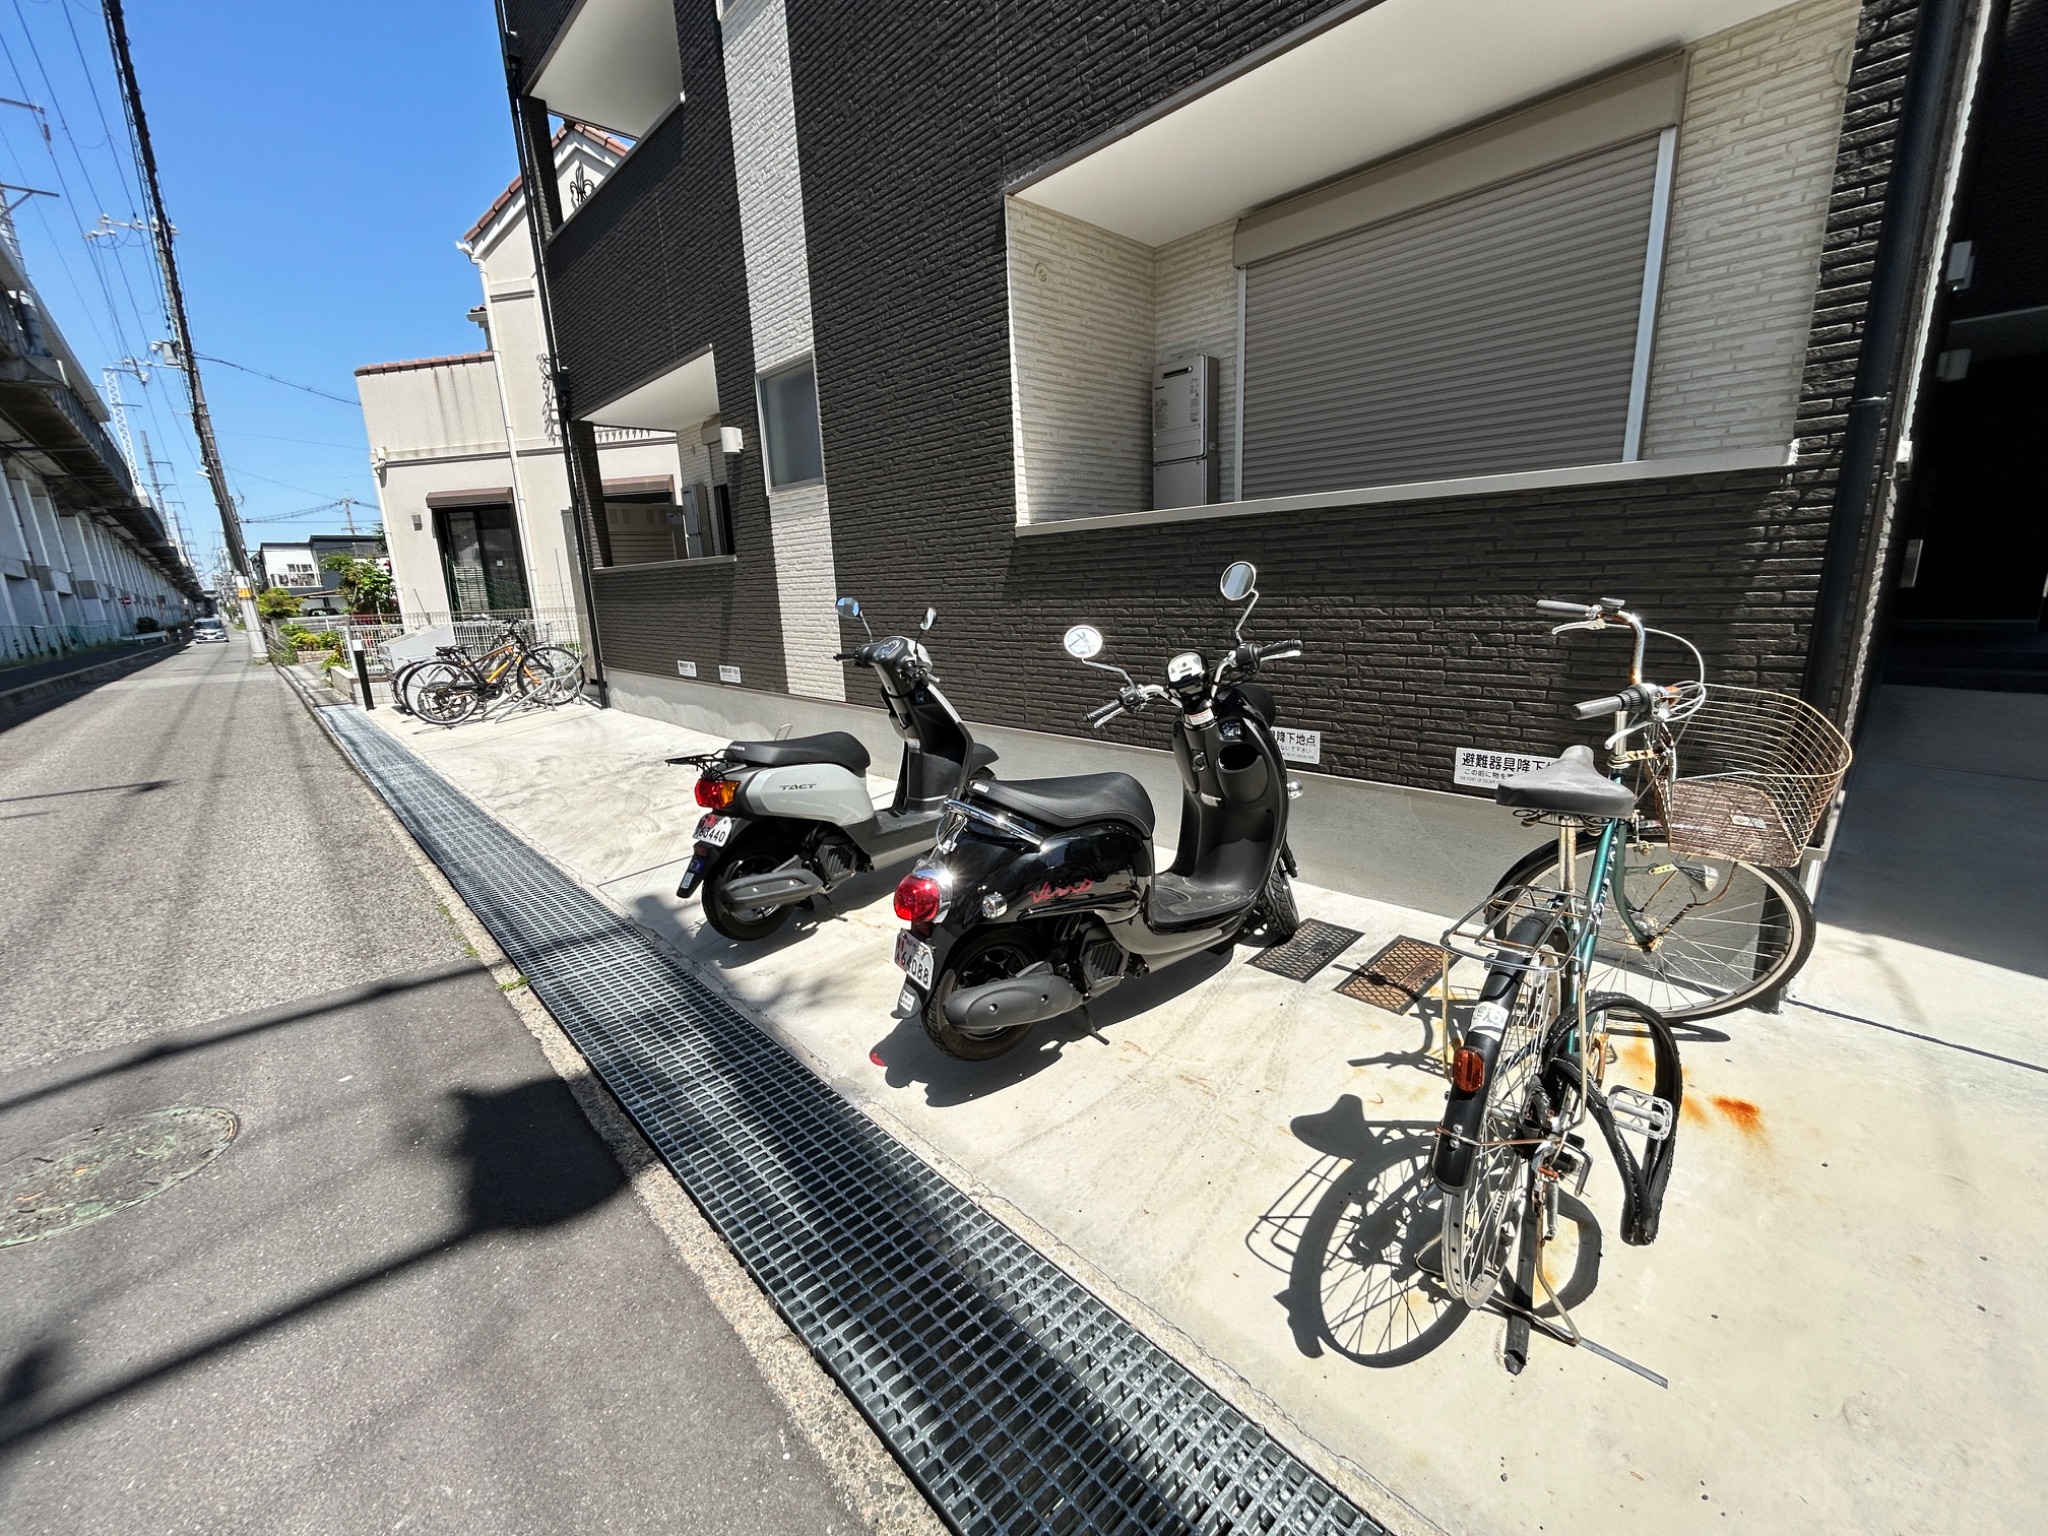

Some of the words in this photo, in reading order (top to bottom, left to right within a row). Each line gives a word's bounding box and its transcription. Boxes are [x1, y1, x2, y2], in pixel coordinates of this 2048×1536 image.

[1462, 752, 1552, 773] 避難器具降下
